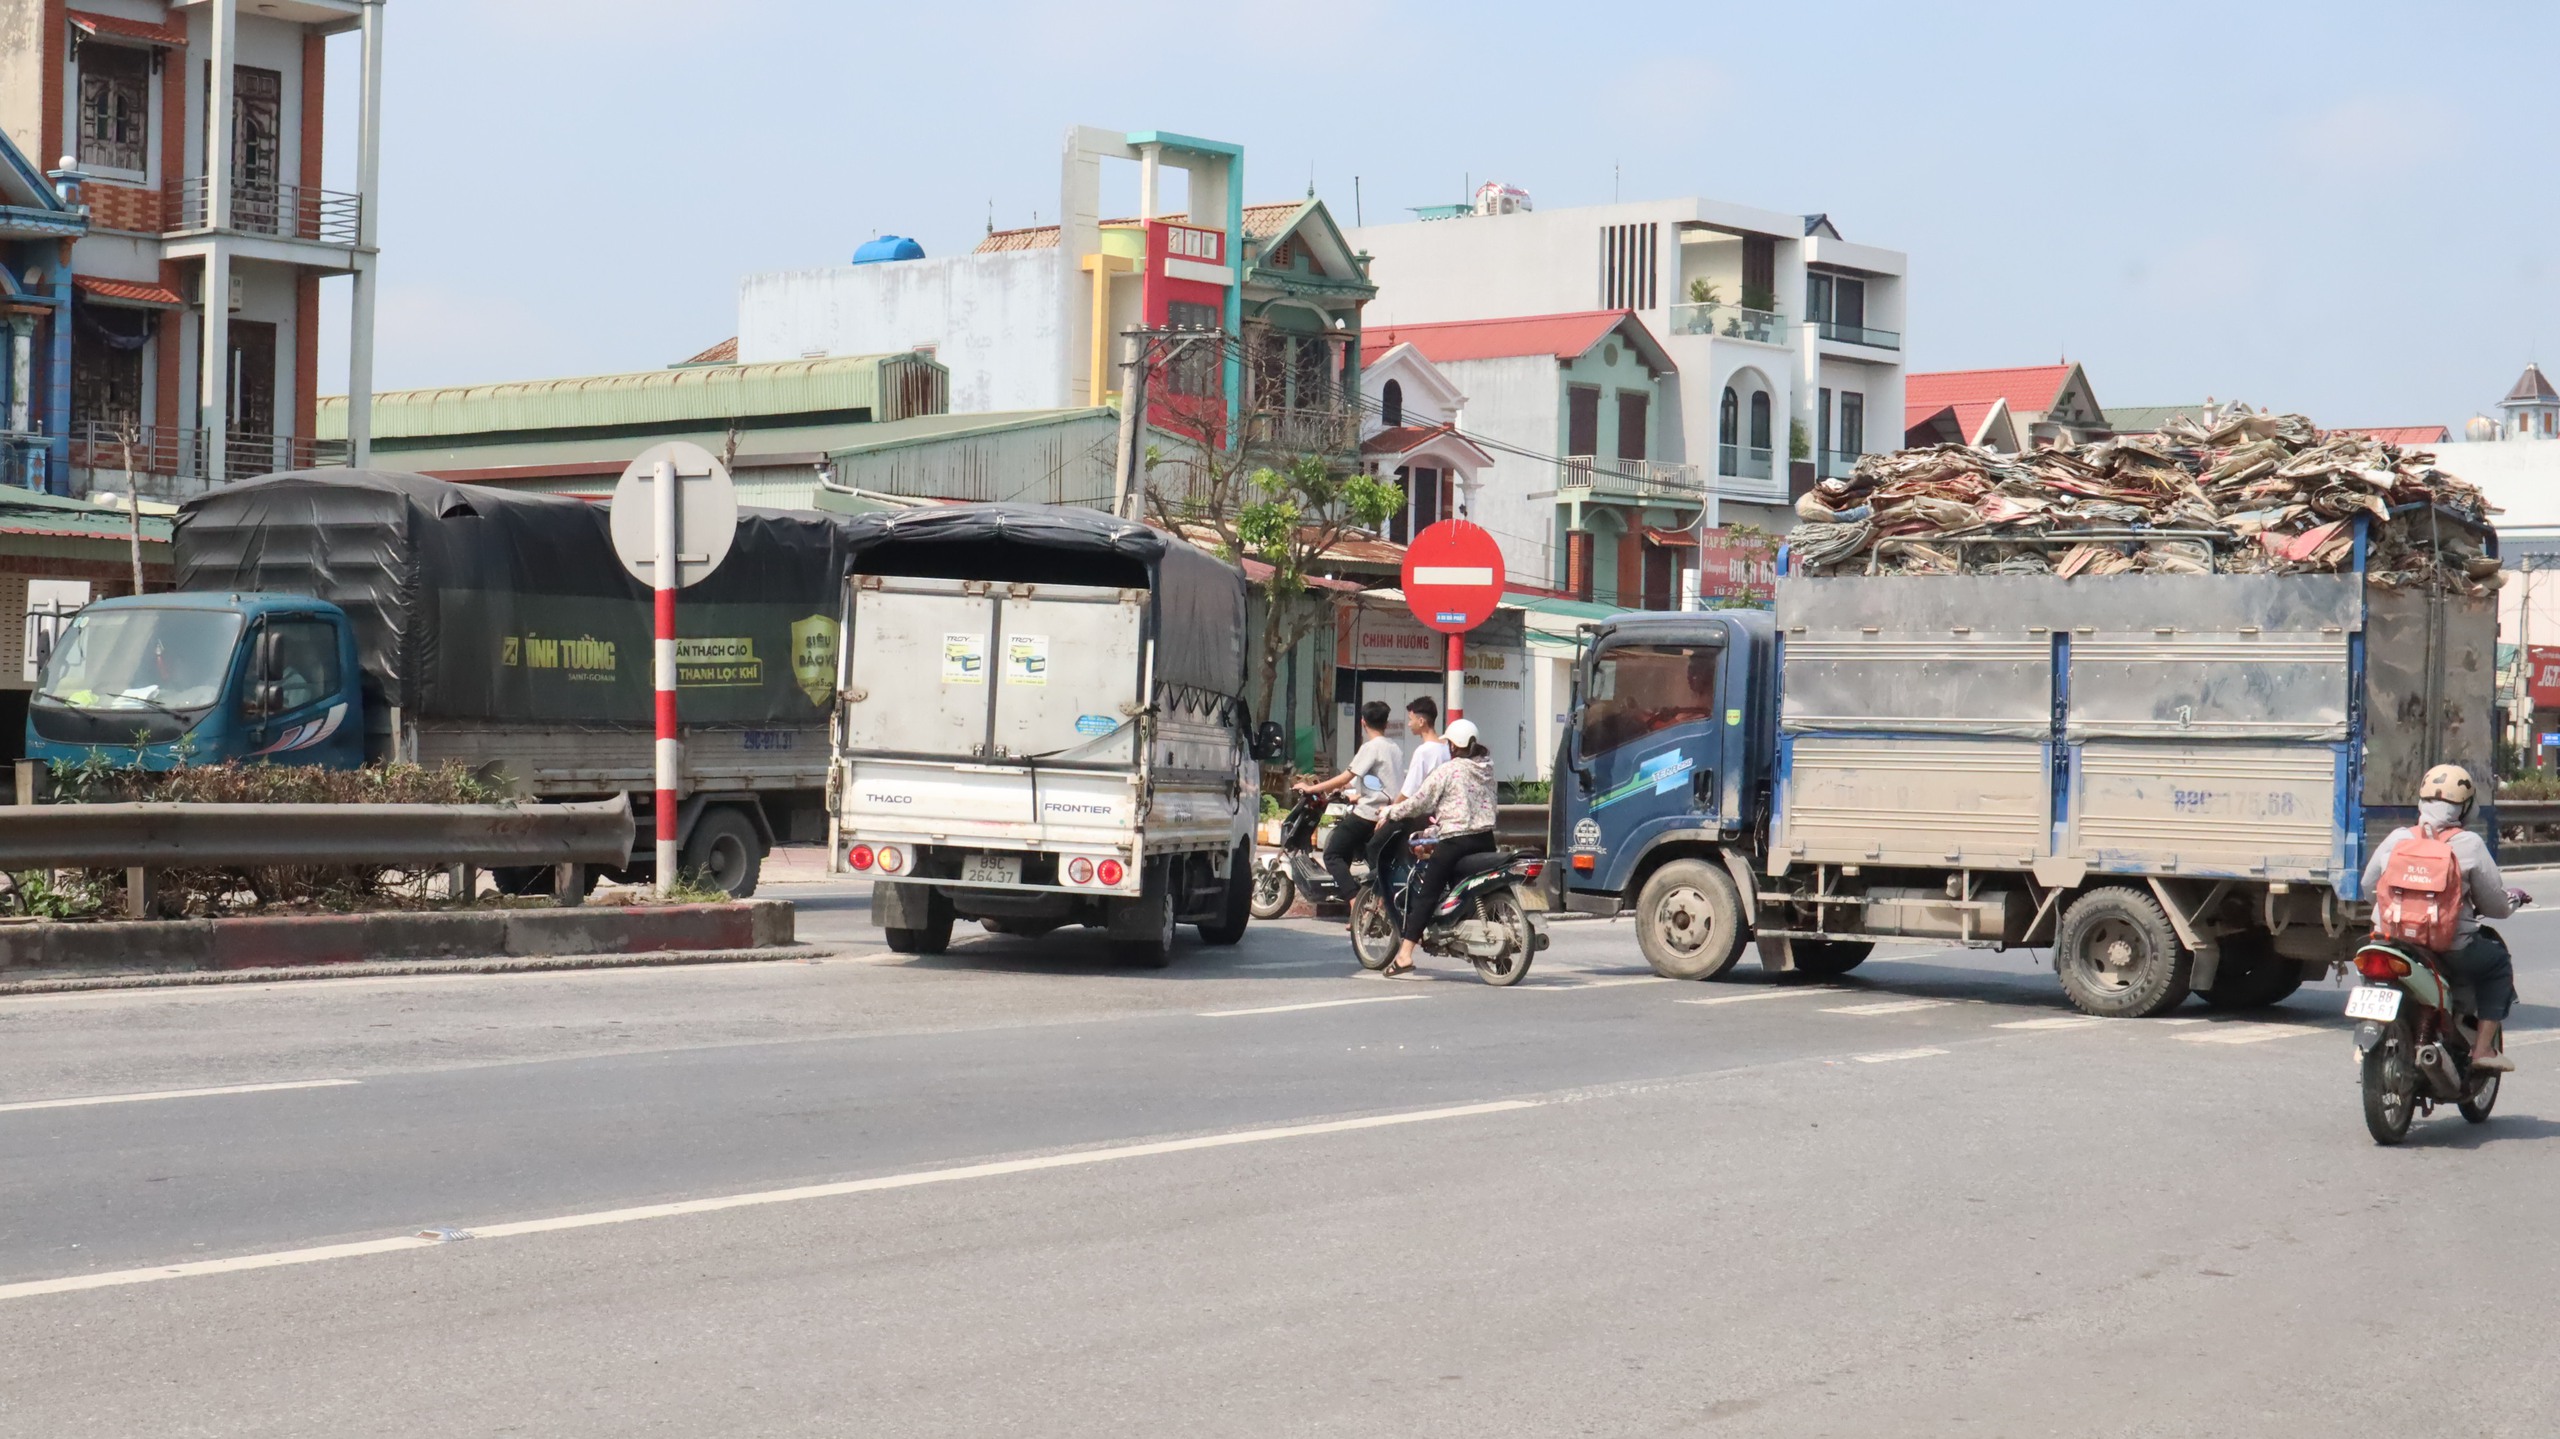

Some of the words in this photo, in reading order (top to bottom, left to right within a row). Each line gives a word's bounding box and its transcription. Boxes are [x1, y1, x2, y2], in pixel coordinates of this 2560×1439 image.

[692, 645, 725, 659] THẠCH
[727, 644, 748, 656] CAO
[679, 667, 715, 680] THANH
[866, 794, 912, 804] THACO
[1044, 803, 1112, 815] FRONTIER
[980, 856, 1005, 869] 89C
[968, 869, 1014, 884] 264.37
